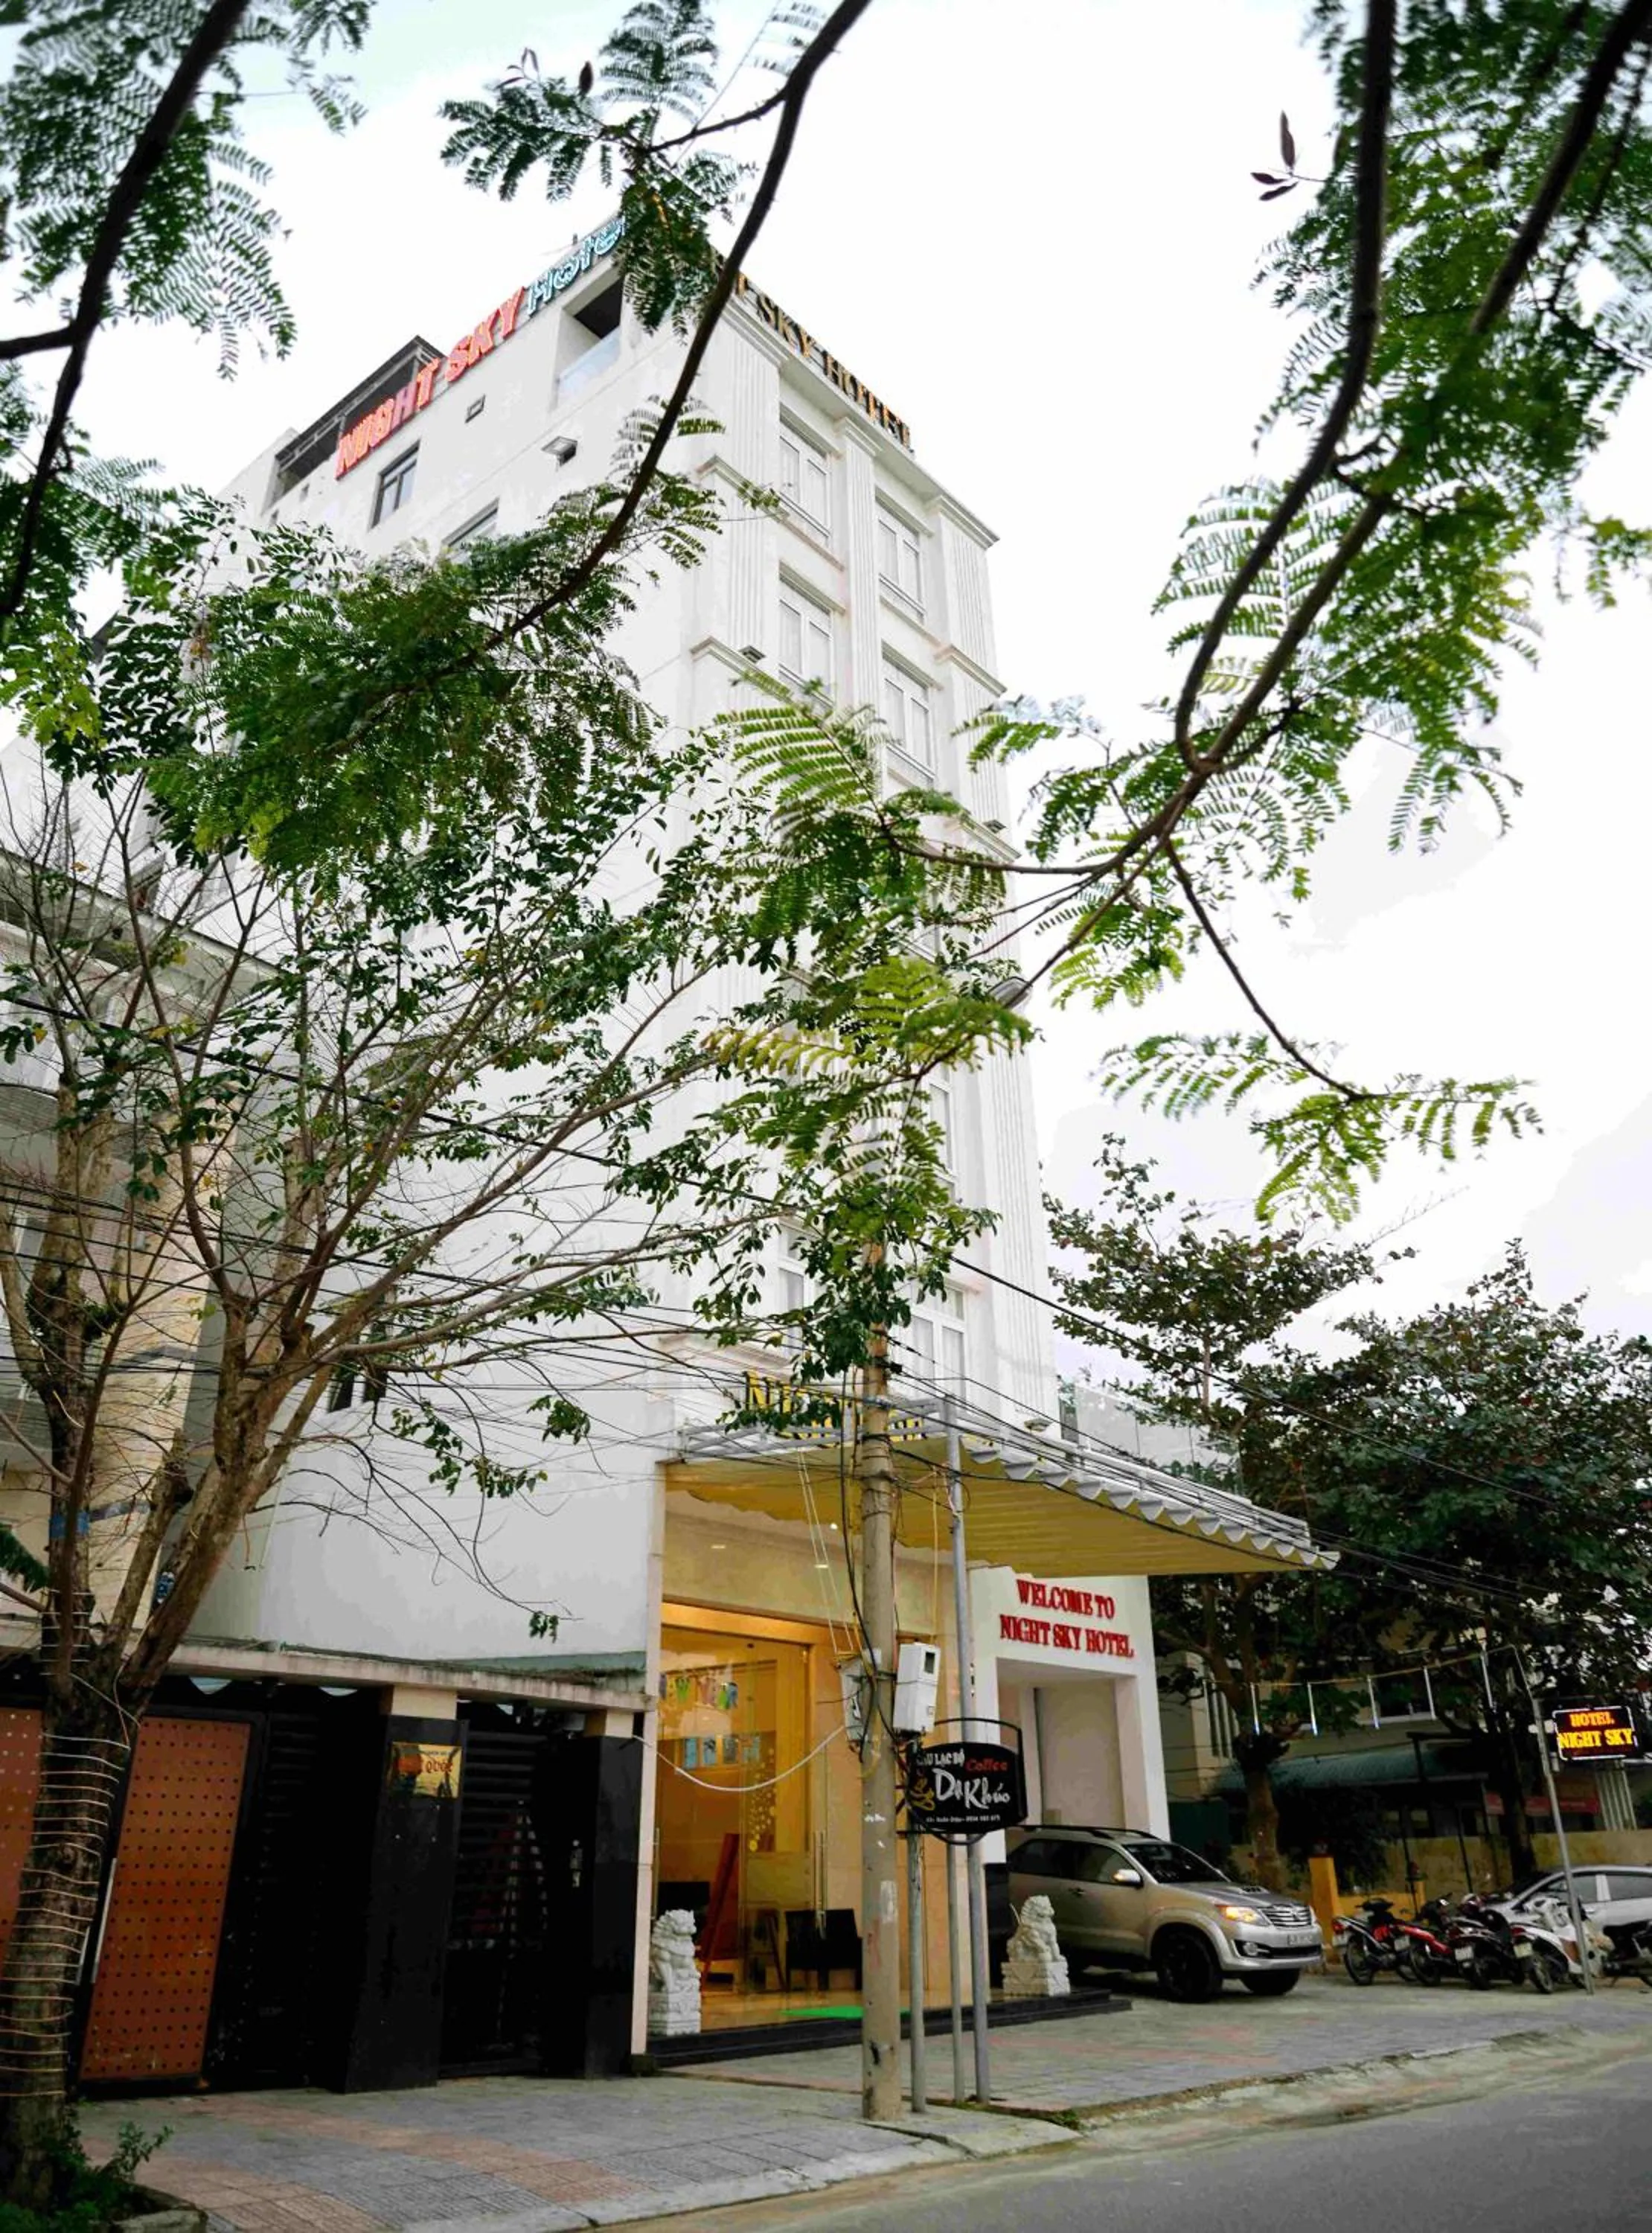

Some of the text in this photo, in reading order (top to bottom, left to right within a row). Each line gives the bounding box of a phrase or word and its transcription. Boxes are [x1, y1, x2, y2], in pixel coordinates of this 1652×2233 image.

[336, 357, 441, 479] NIGHT
[445, 286, 525, 382] SKY
[822, 351, 910, 448] HOTEL
[1017, 1579, 1115, 1620] WELCOME TO
[999, 1614, 1135, 1658] NIGHT SKY HOTEL
[1558, 1728, 1633, 1748] NIGHT SKY
